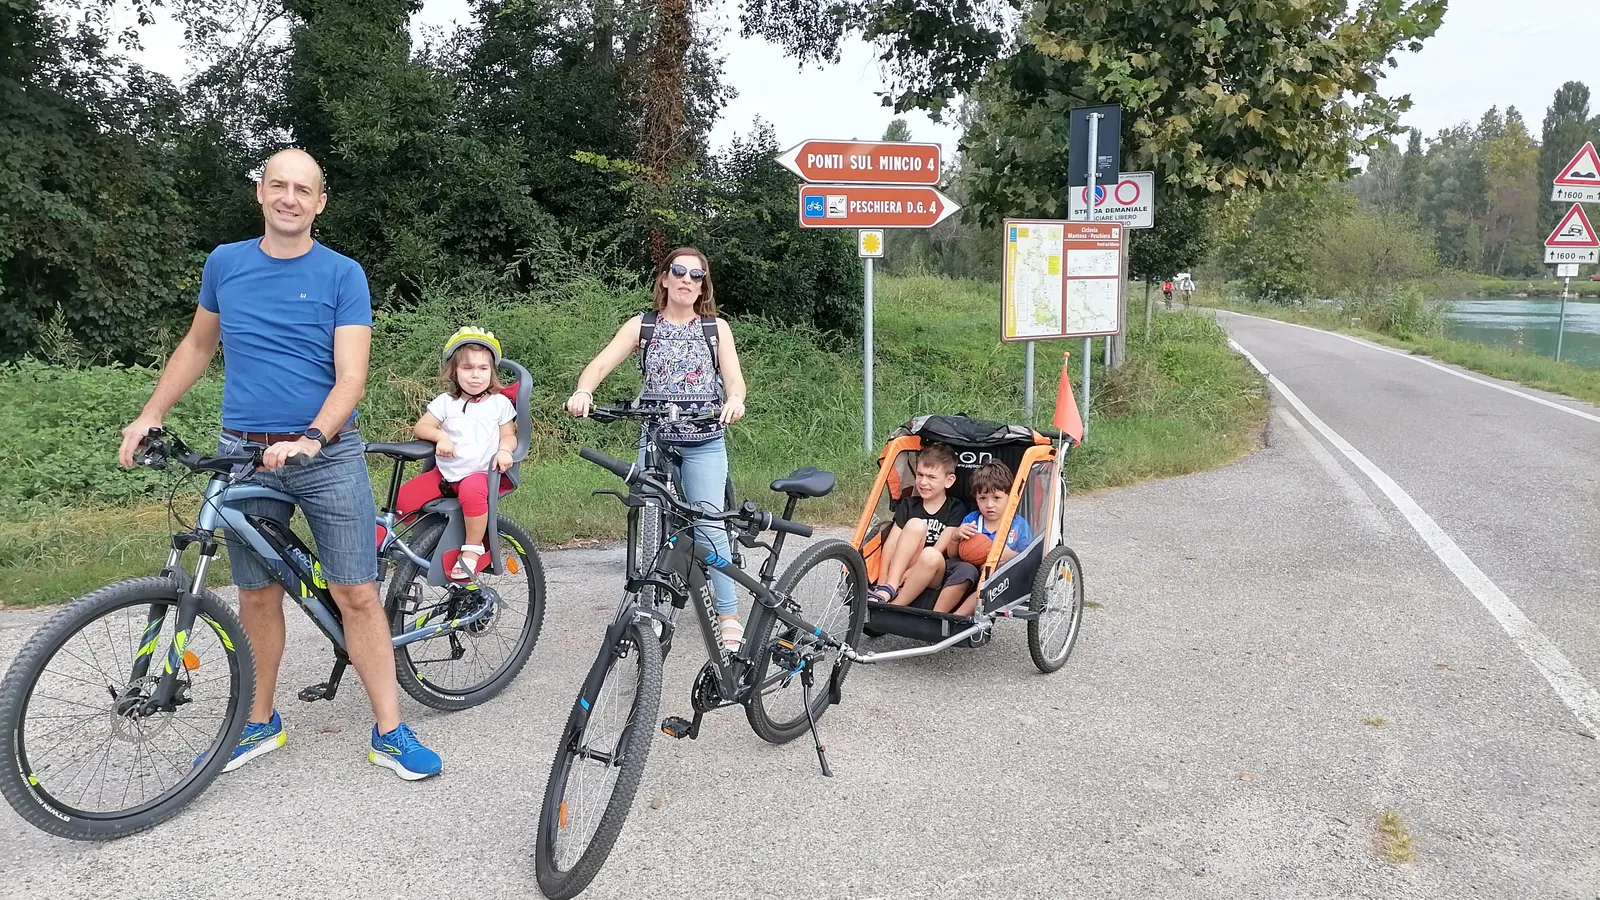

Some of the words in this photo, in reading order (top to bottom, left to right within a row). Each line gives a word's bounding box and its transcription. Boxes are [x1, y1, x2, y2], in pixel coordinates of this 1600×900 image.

[807, 153, 843, 169] PONTI
[850, 154, 873, 170] SUL
[879, 155, 922, 171] MINCIO
[927, 157, 935, 171] 4
[1564, 191, 1582, 199] 1600
[850, 201, 902, 214] PESCHIERA
[907, 201, 926, 214] D.G.
[929, 201, 937, 214] 4
[699, 584, 731, 668] ROCKRIDER
